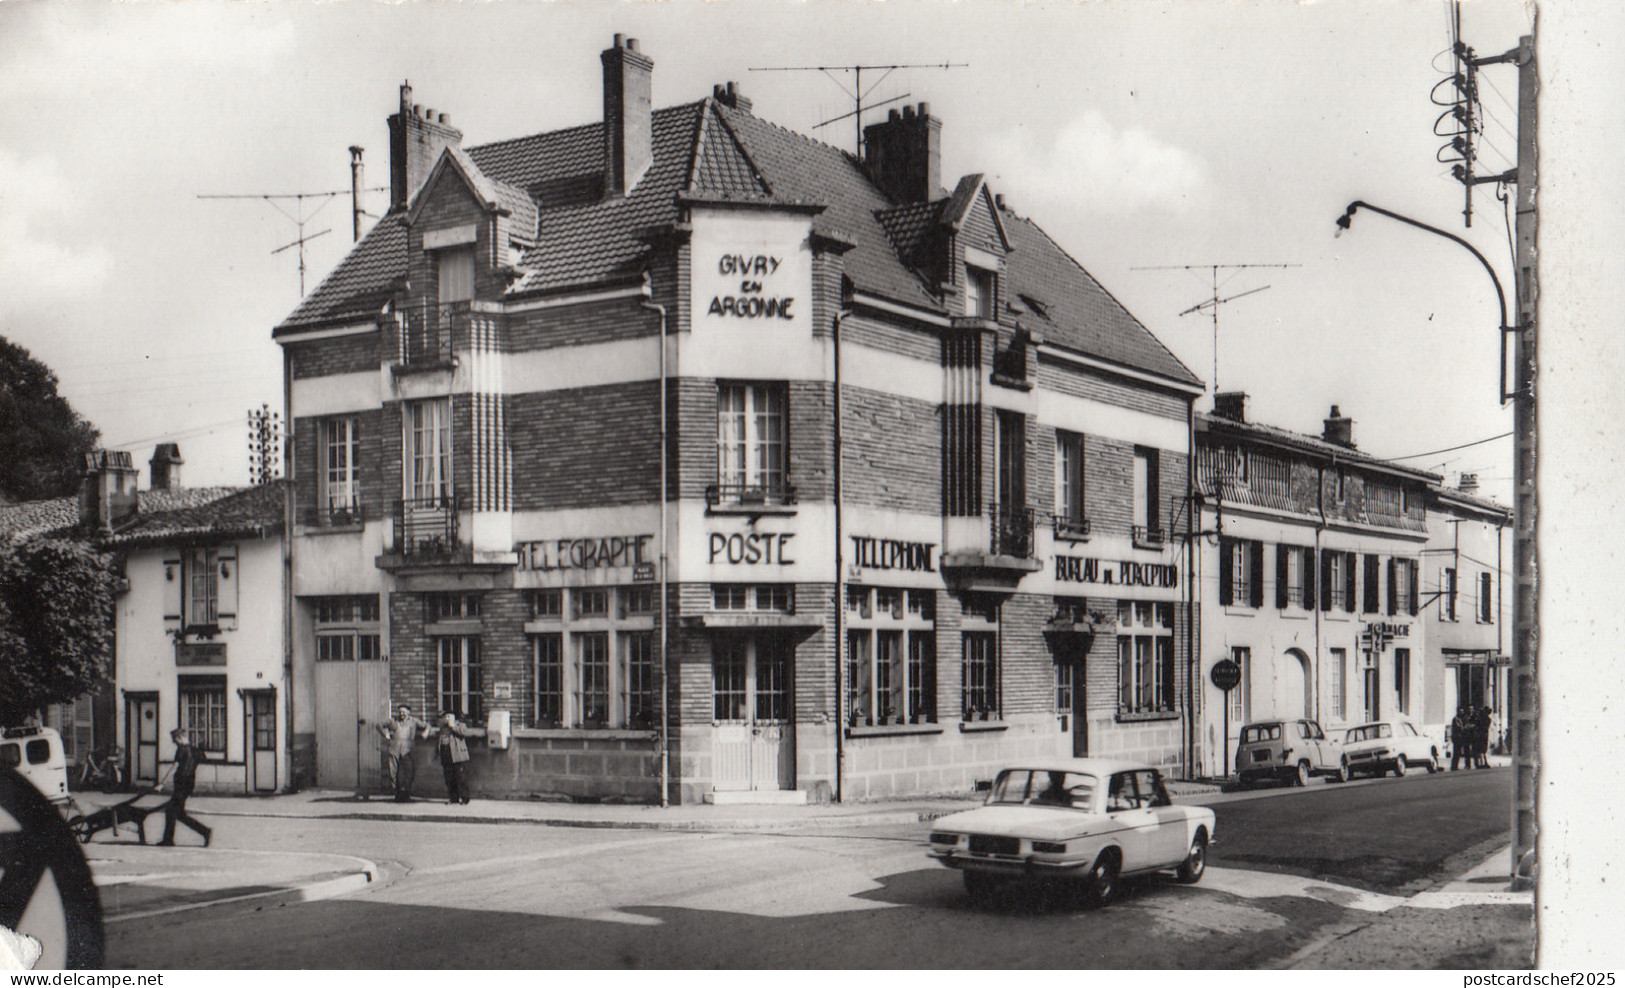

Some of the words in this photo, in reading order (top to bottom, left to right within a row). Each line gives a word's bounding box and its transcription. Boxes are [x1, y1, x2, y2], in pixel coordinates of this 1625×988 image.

[719, 254, 783, 276] GIVRY
[707, 296, 794, 319] ARGONNE
[709, 533, 795, 564] POSTE
[850, 535, 937, 573] TELEPHONE
[1055, 555, 1098, 583] BUREAU
[1120, 561, 1177, 588] PERCEPTION
